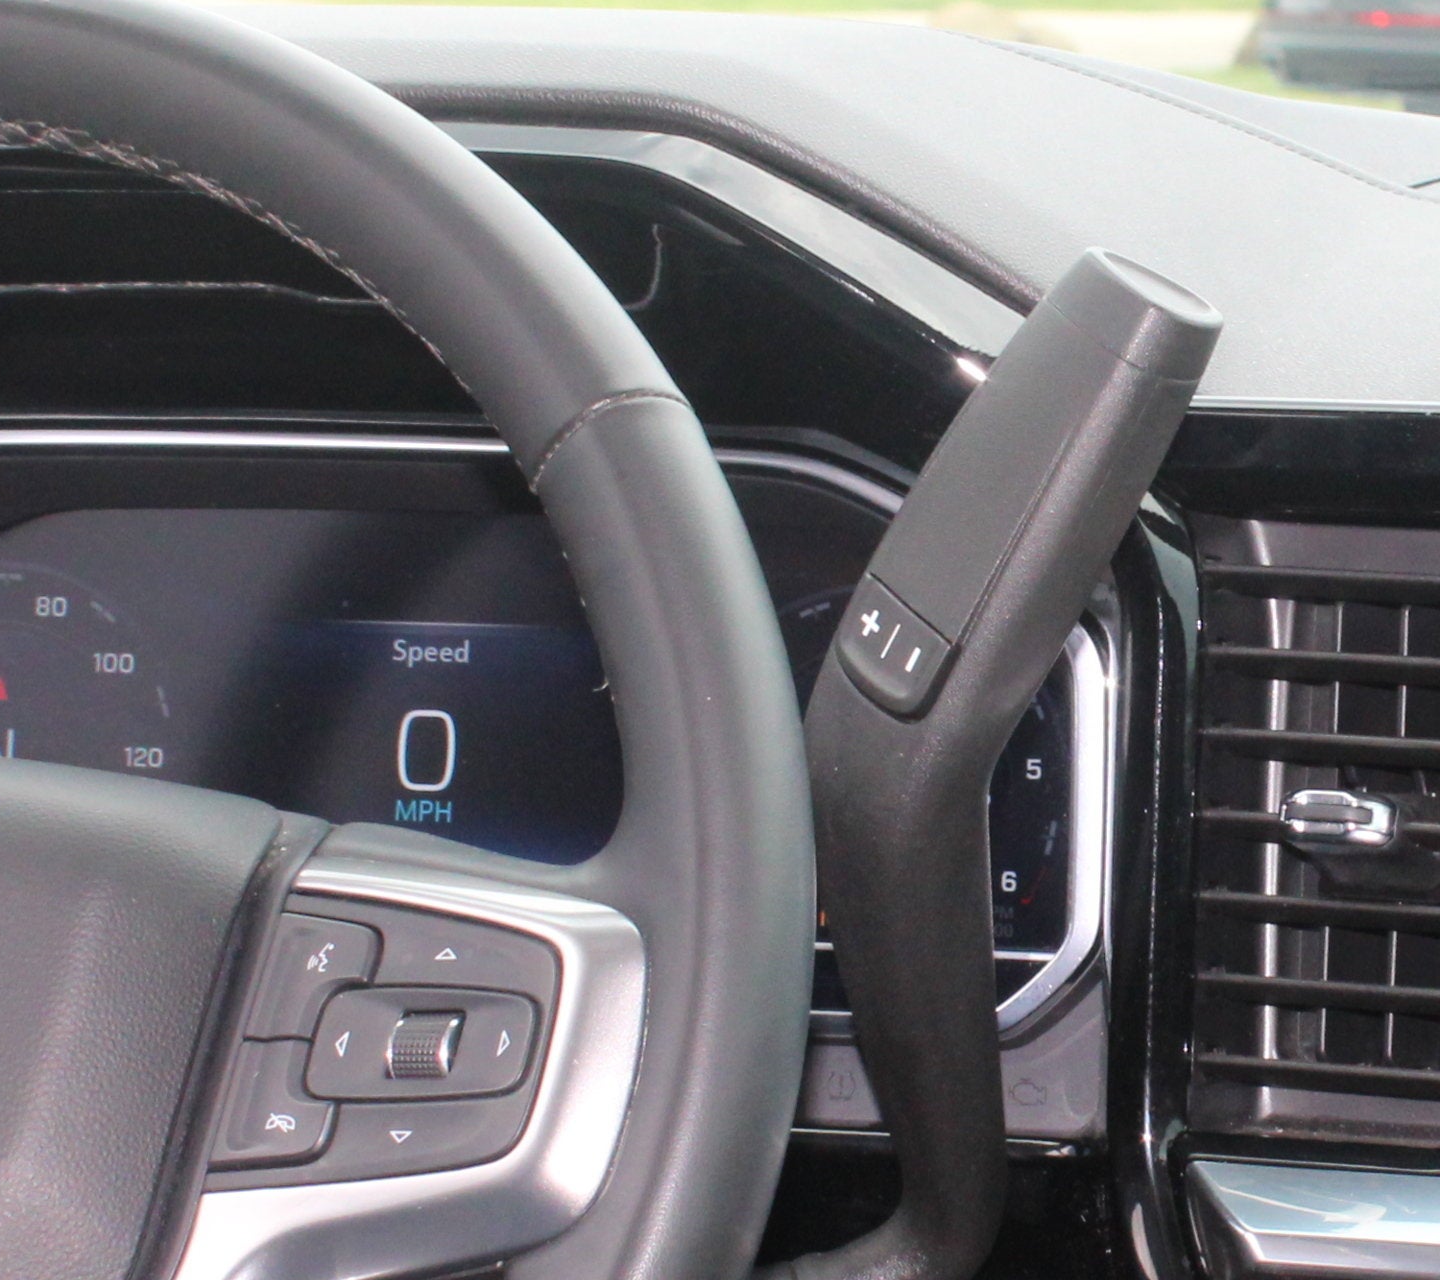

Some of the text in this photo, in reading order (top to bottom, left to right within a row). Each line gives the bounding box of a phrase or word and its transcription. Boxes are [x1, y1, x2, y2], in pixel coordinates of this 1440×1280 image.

[35, 597, 67, 617] 80
[392, 639, 470, 666] Speed
[93, 653, 134, 674] 100
[124, 747, 164, 768] 120
[397, 709, 456, 792] 0
[1026, 758, 1042, 780] 5
[393, 800, 452, 823] MPH
[1000, 871, 1017, 892] 6
